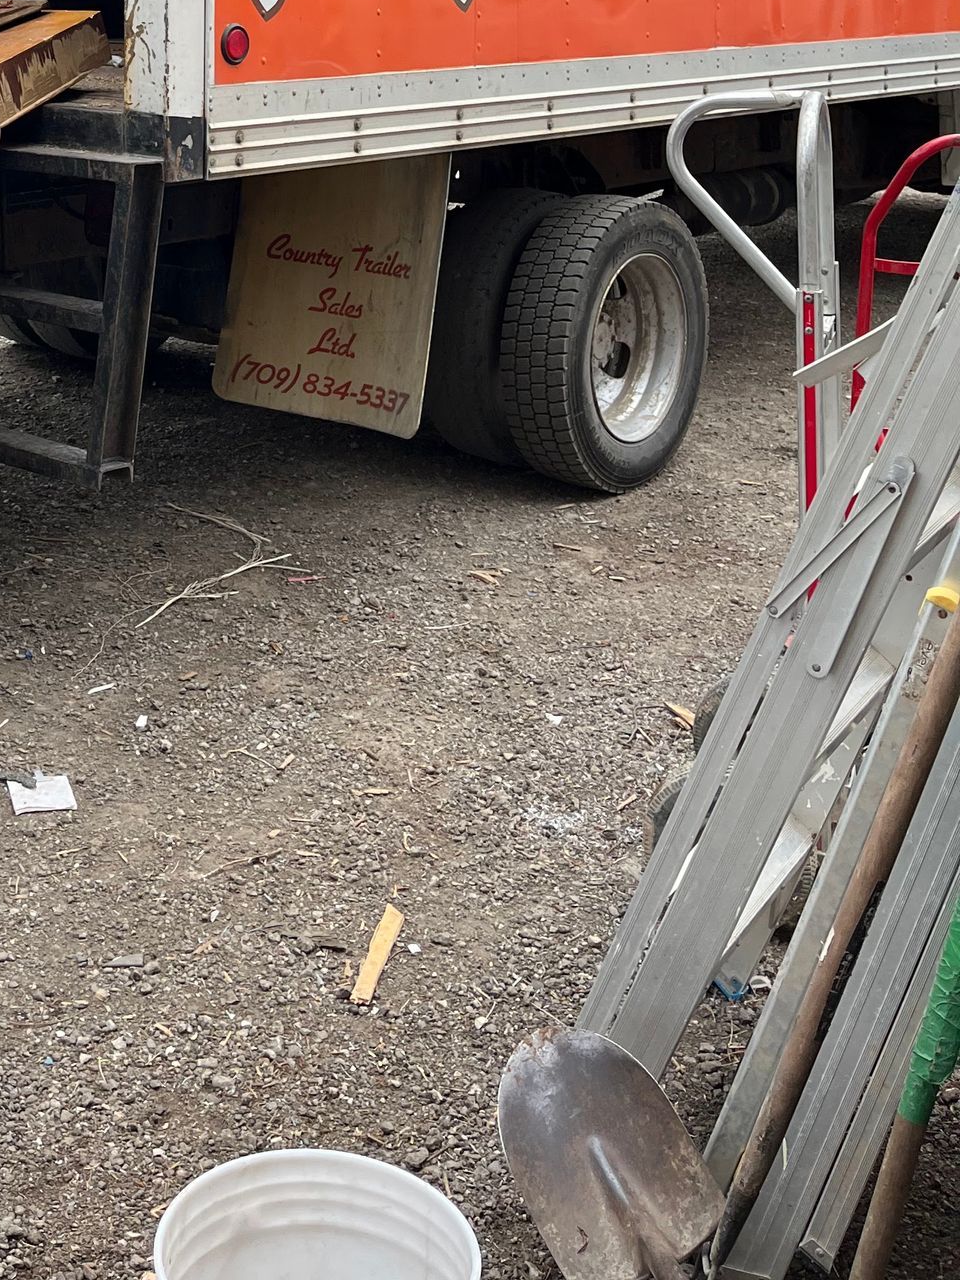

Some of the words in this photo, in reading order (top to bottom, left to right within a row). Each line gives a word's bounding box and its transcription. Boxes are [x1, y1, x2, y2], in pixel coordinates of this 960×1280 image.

[267, 234, 342, 278] Country
[352, 244, 411, 279] Trailer
[308, 288, 362, 318] Sales
[307, 328, 356, 358] Ltd.
[231, 354, 301, 393] (709)
[303, 373, 409, 415] 834-5337
